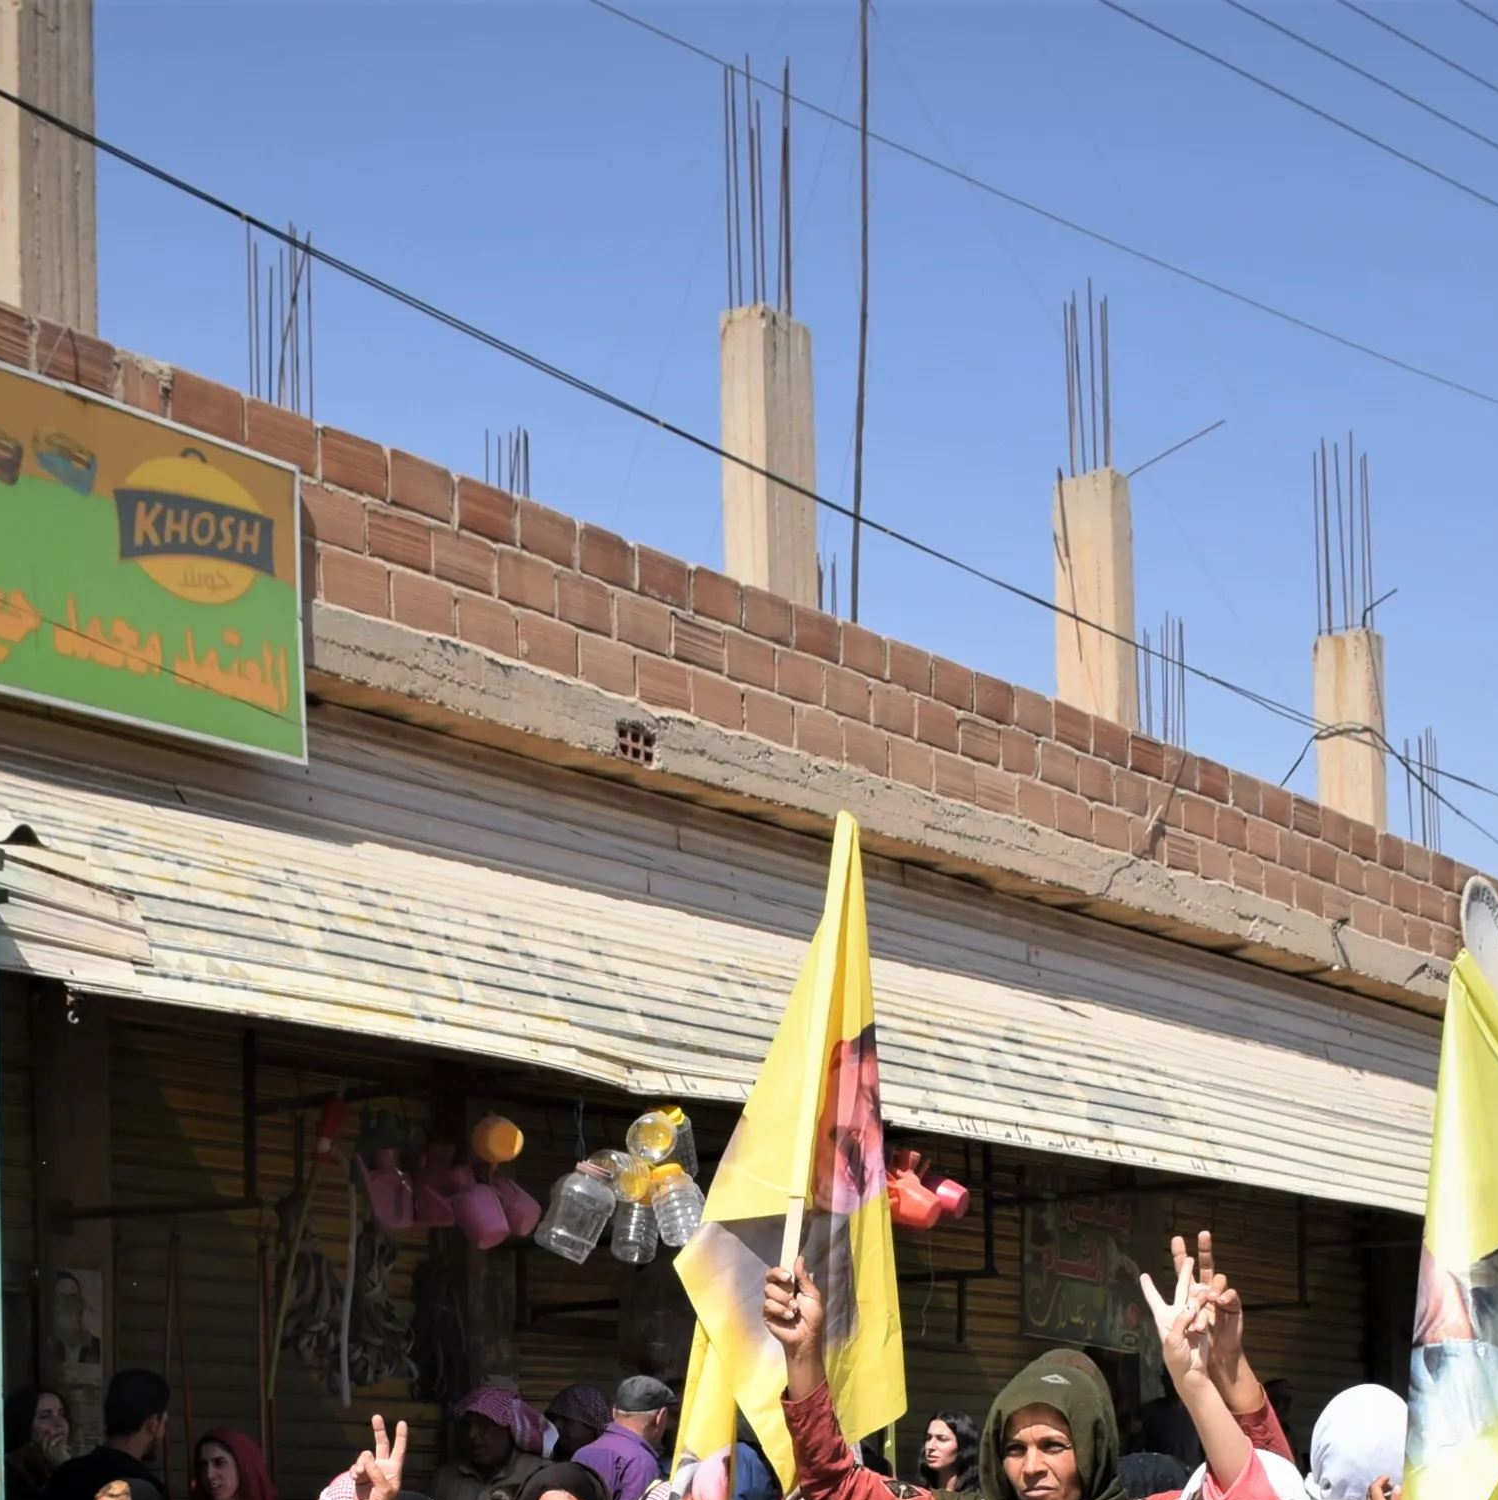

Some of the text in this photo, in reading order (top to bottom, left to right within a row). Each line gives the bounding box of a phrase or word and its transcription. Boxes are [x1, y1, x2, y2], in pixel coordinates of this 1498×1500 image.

[134, 501, 261, 555] KHOSH
[53, 595, 163, 676] محمد
[173, 627, 289, 712] المعتمد
